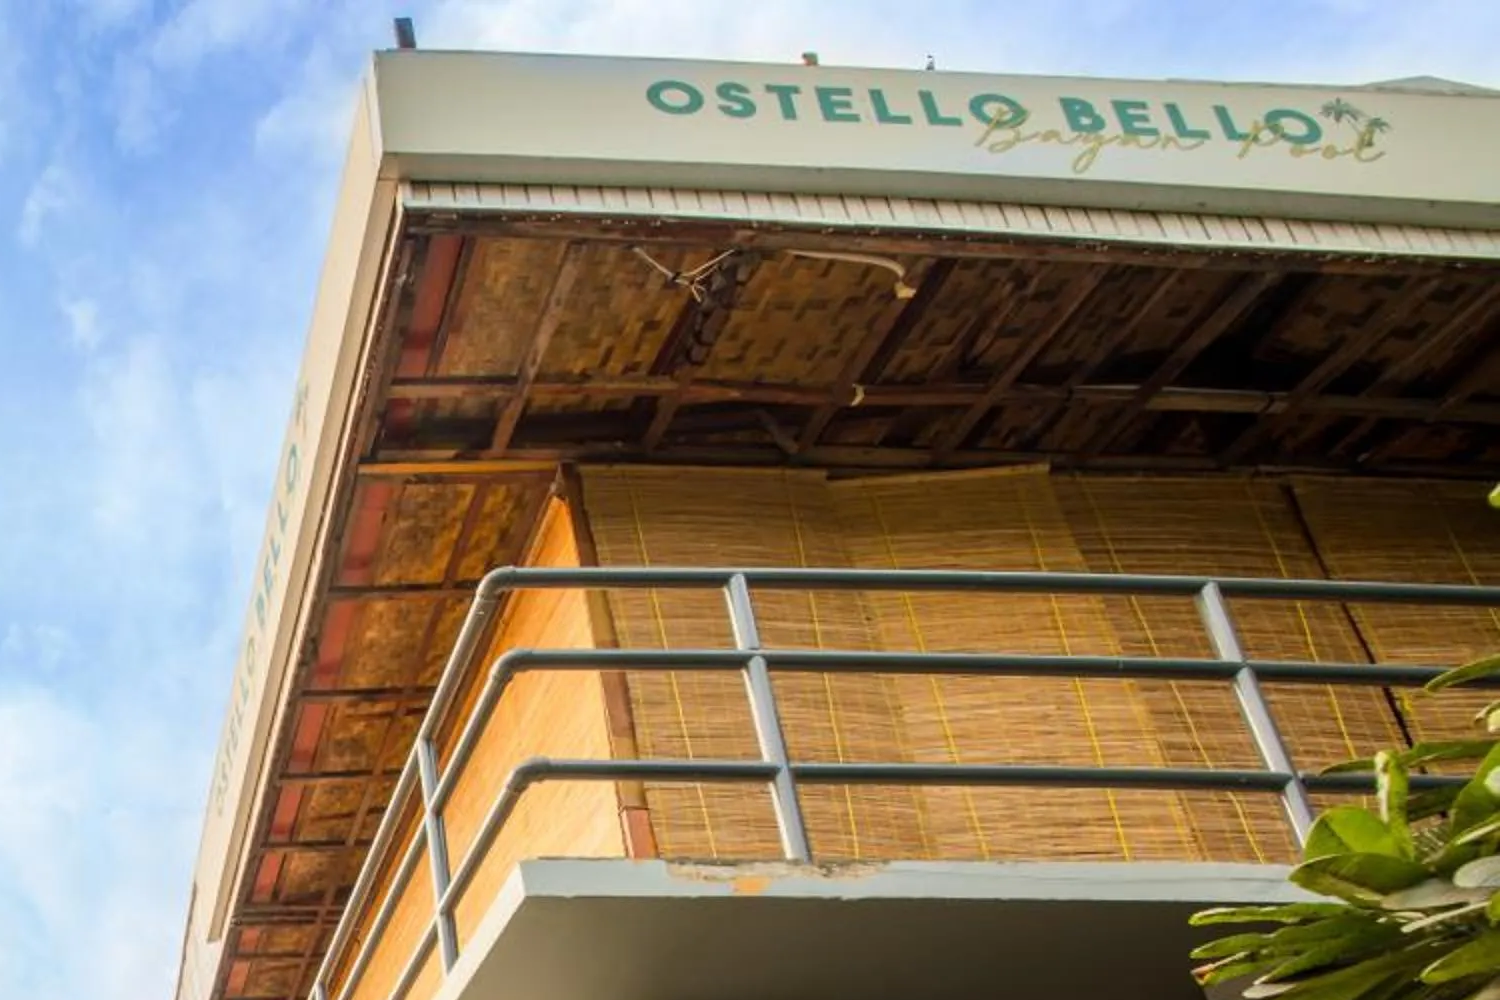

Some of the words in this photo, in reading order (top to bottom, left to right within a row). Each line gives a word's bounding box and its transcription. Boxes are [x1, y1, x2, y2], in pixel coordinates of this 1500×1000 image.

[646, 79, 1029, 127] OSTELLO
[1058, 96, 1322, 145] BELLO
[975, 107, 1205, 174] Bagan
